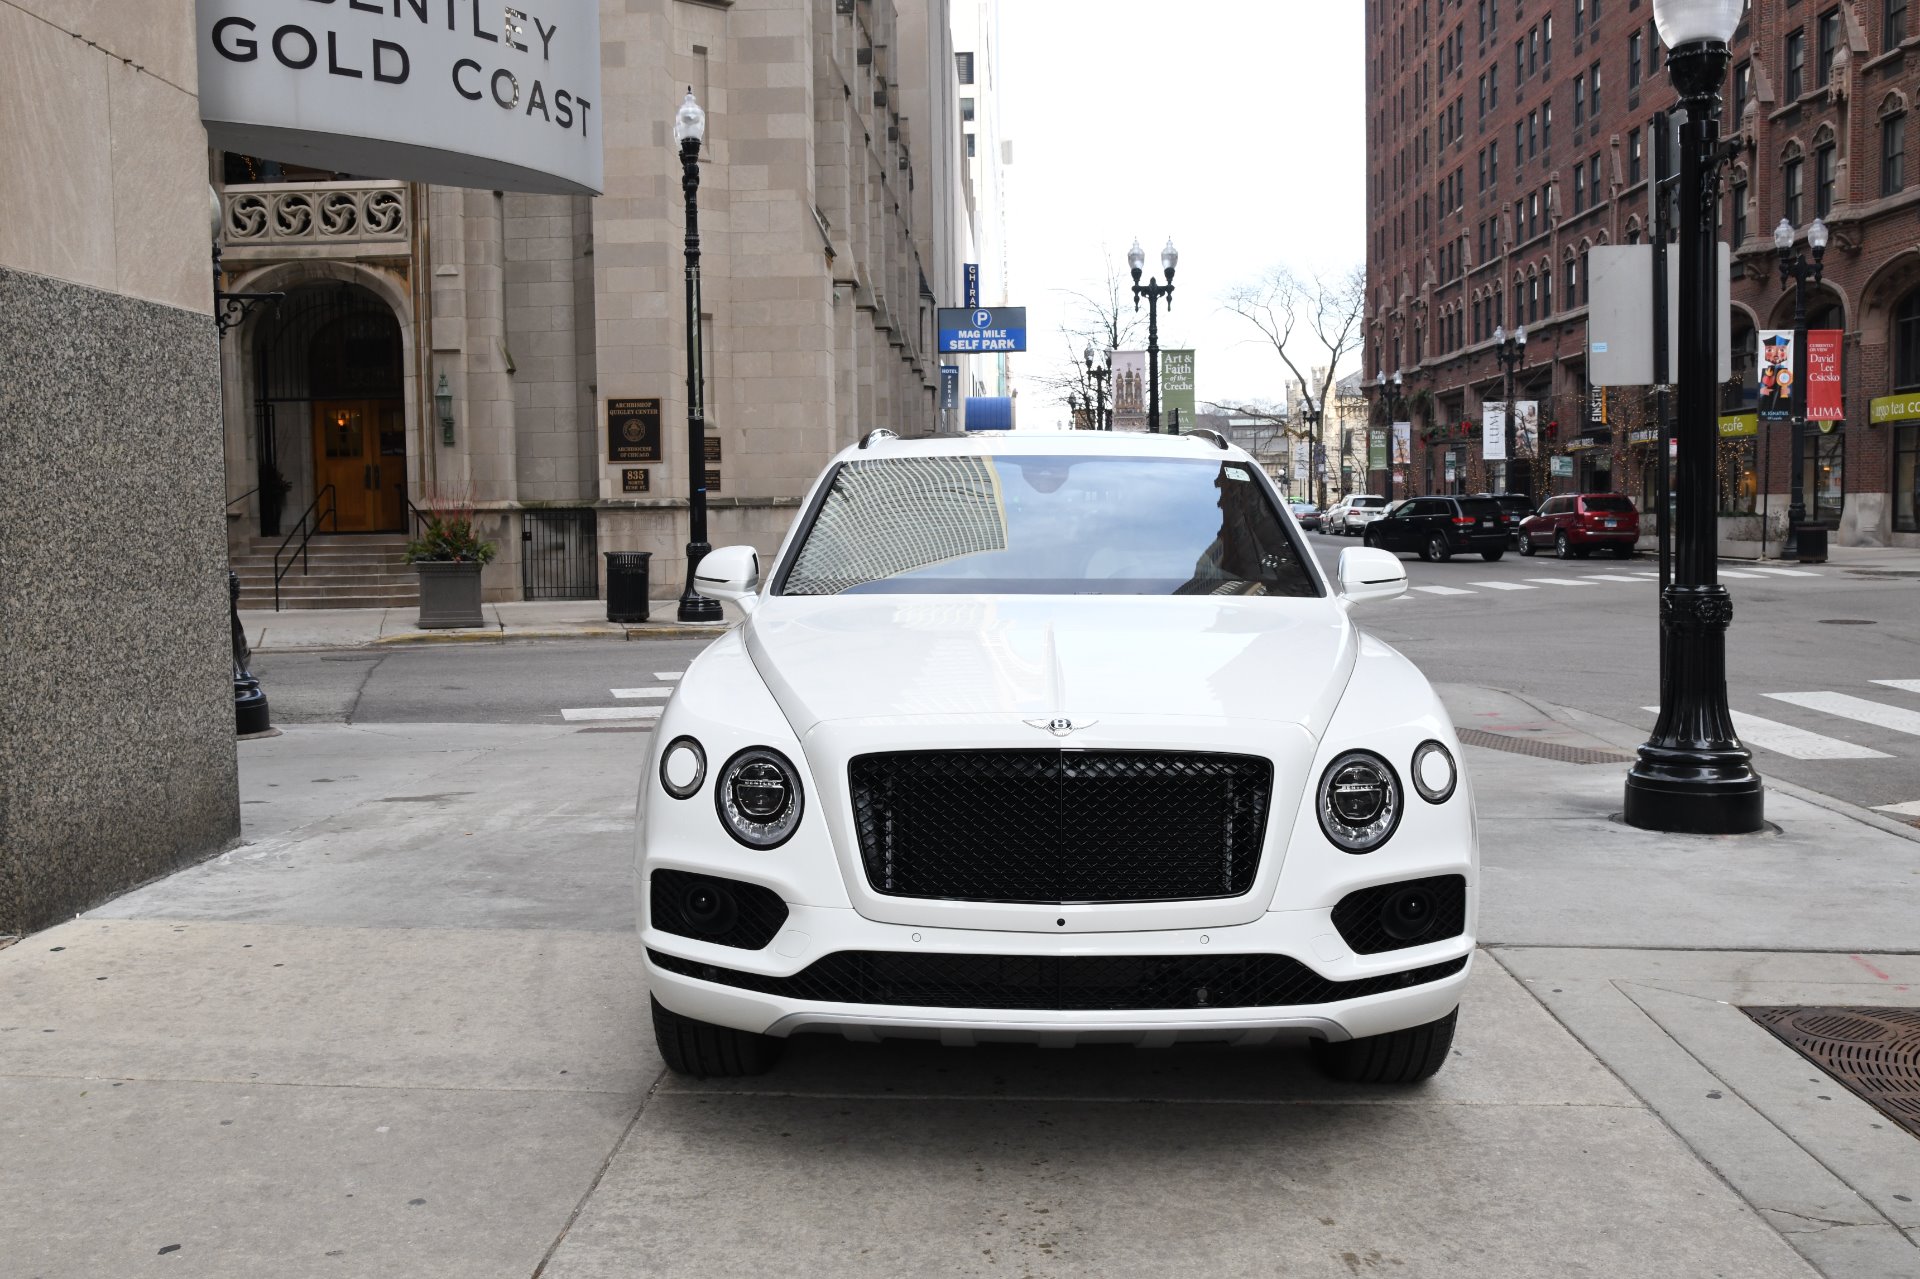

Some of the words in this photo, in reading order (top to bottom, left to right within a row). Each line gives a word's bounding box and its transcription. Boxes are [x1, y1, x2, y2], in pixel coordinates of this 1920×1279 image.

[211, 16, 410, 85] GOLD
[452, 58, 591, 137] COAST
[958, 330, 981, 338] MAG
[982, 329, 1007, 338] MILE
[949, 339, 979, 350] SELF
[982, 339, 1015, 350] PARK
[1164, 353, 1182, 364] Art
[1184, 354, 1192, 363] &
[1810, 353, 1834, 363] David
[1165, 363, 1191, 374] Faith
[1820, 362, 1834, 372] Lee
[1809, 372, 1840, 382] Csicsko
[1164, 381, 1193, 391] Creche
[1807, 407, 1842, 417] LUMA
[1891, 401, 1905, 415] tea
[627, 470, 644, 480] 835
